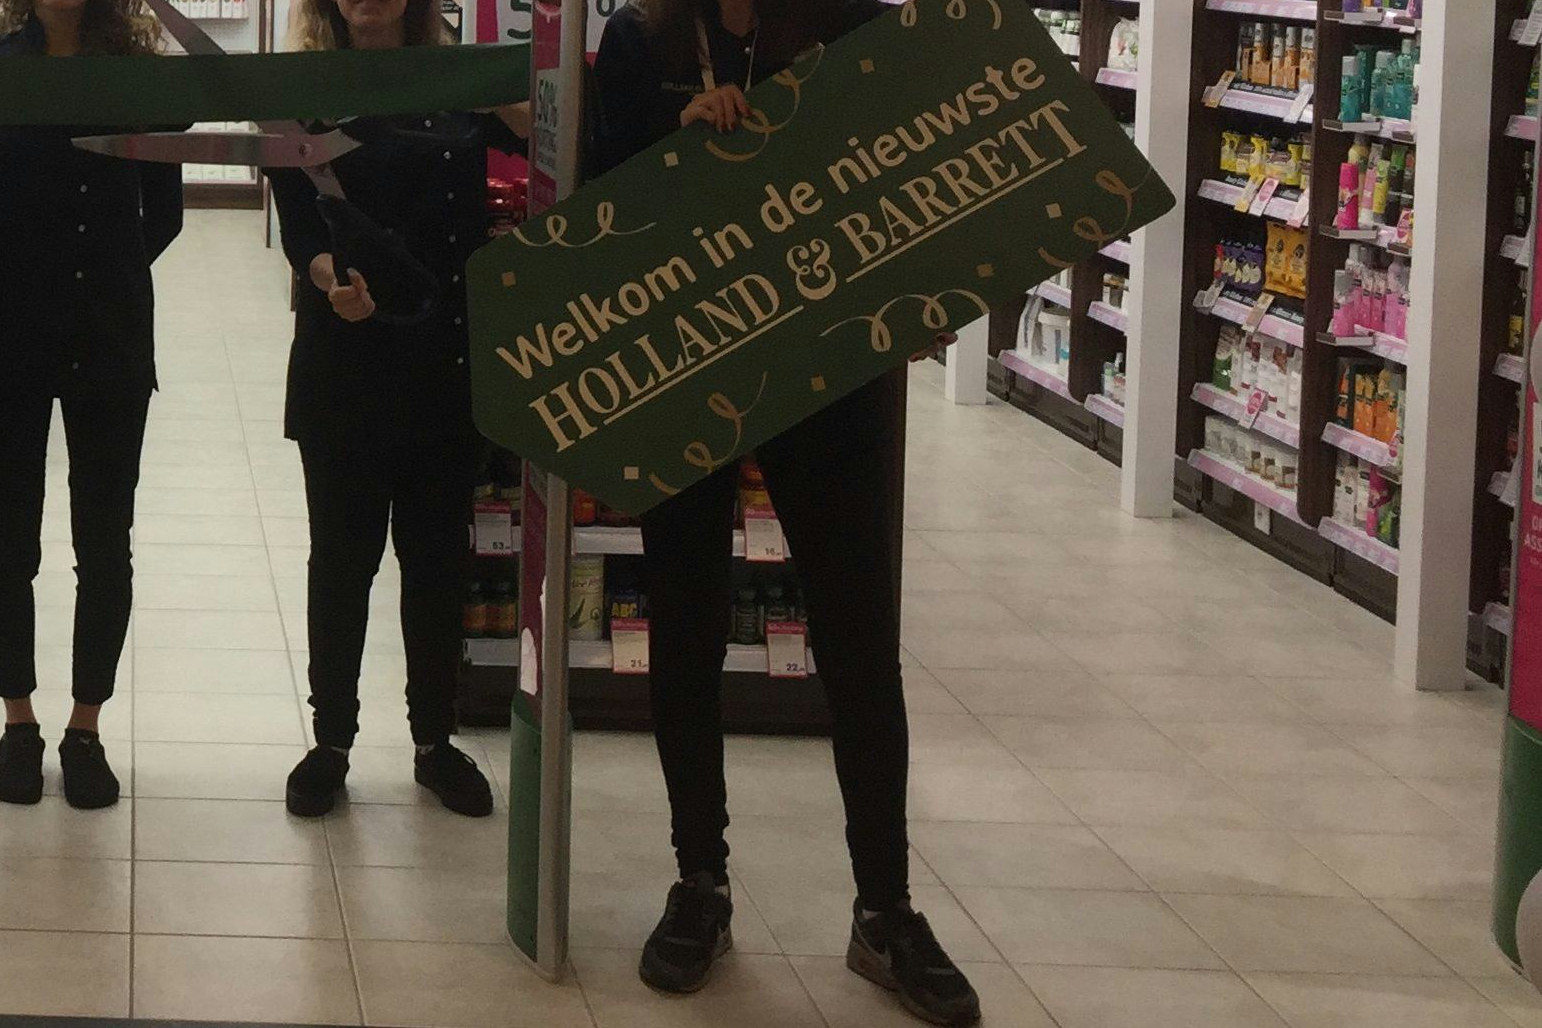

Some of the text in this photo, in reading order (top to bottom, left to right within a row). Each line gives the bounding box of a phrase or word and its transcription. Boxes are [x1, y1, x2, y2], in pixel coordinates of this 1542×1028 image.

[494, 56, 1047, 381] Welkom in de nieuwste
[529, 98, 1088, 453] HOLLAND & BARRETT
